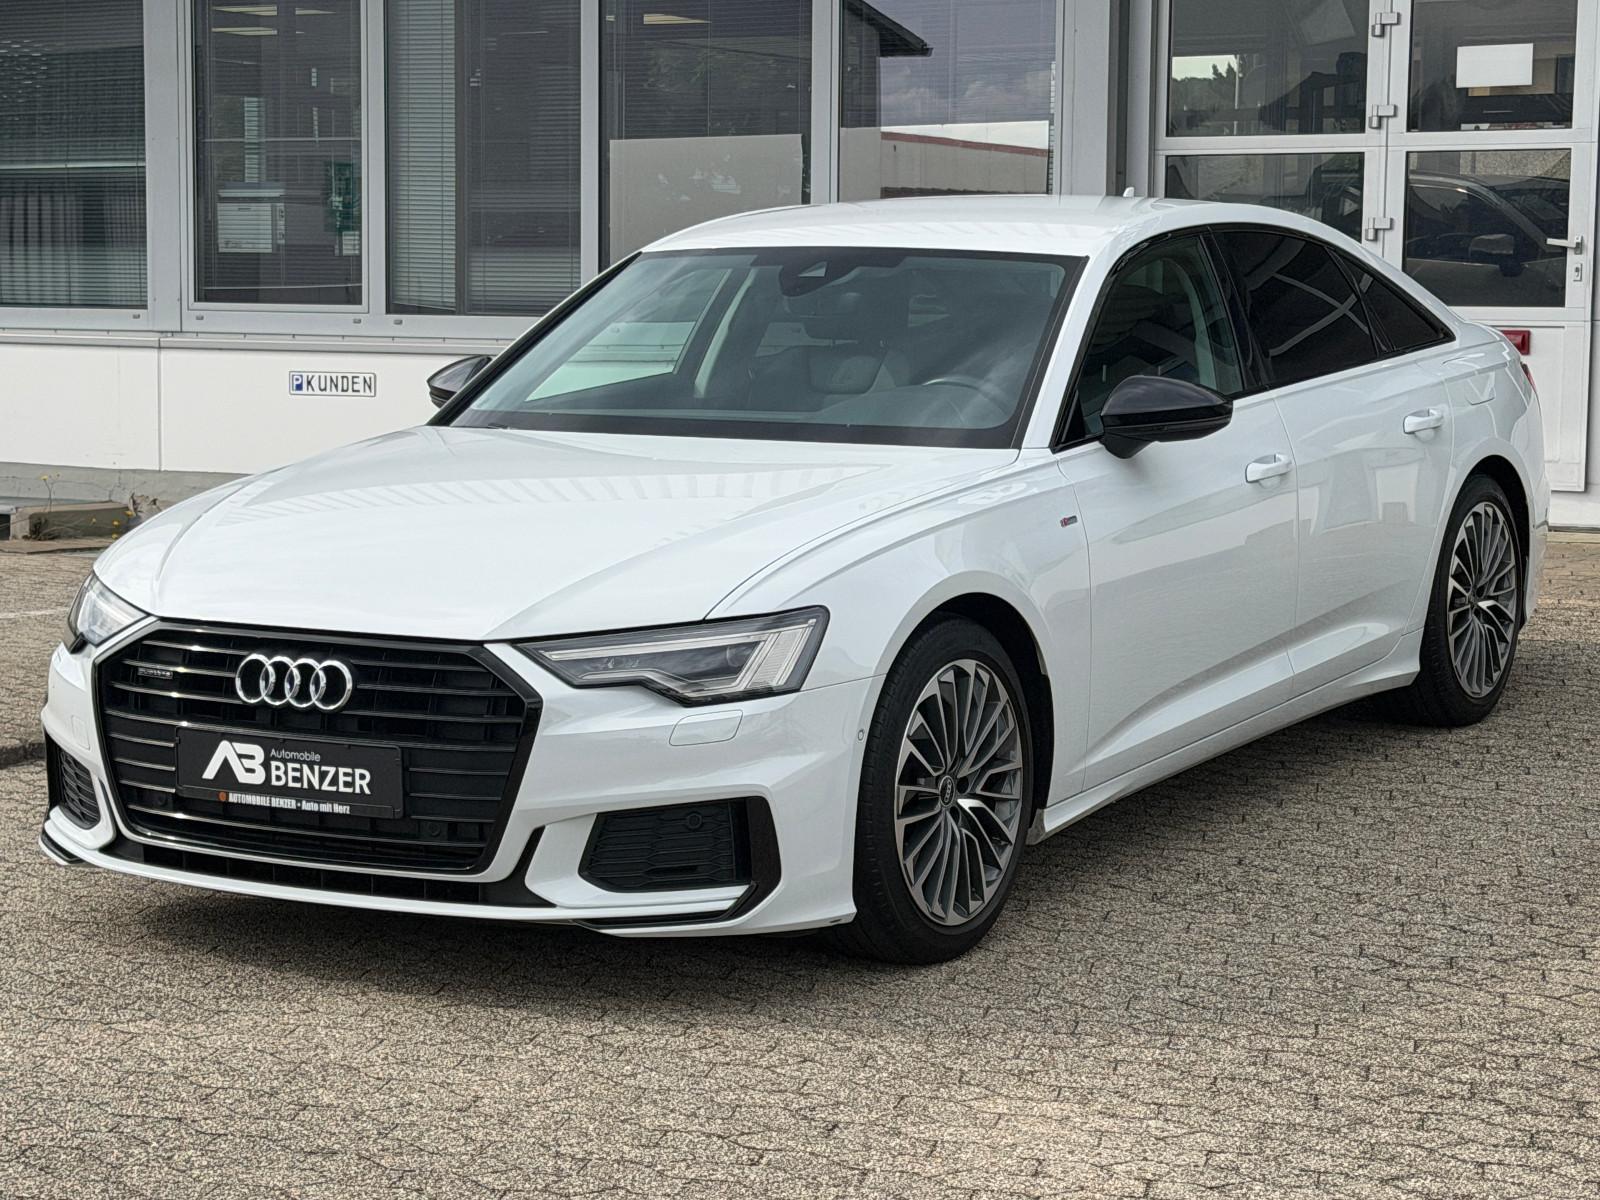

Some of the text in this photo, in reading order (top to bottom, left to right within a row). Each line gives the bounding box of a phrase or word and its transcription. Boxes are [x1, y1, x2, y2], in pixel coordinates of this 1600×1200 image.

[306, 375, 372, 393] KUNDEN
[270, 748, 321, 762] Automobile
[270, 761, 372, 795] BENZER
[228, 793, 270, 807] AUTOMOBILE
[301, 800, 318, 811] Auto
[319, 803, 333, 813] mit
[333, 803, 351, 814] Herz
